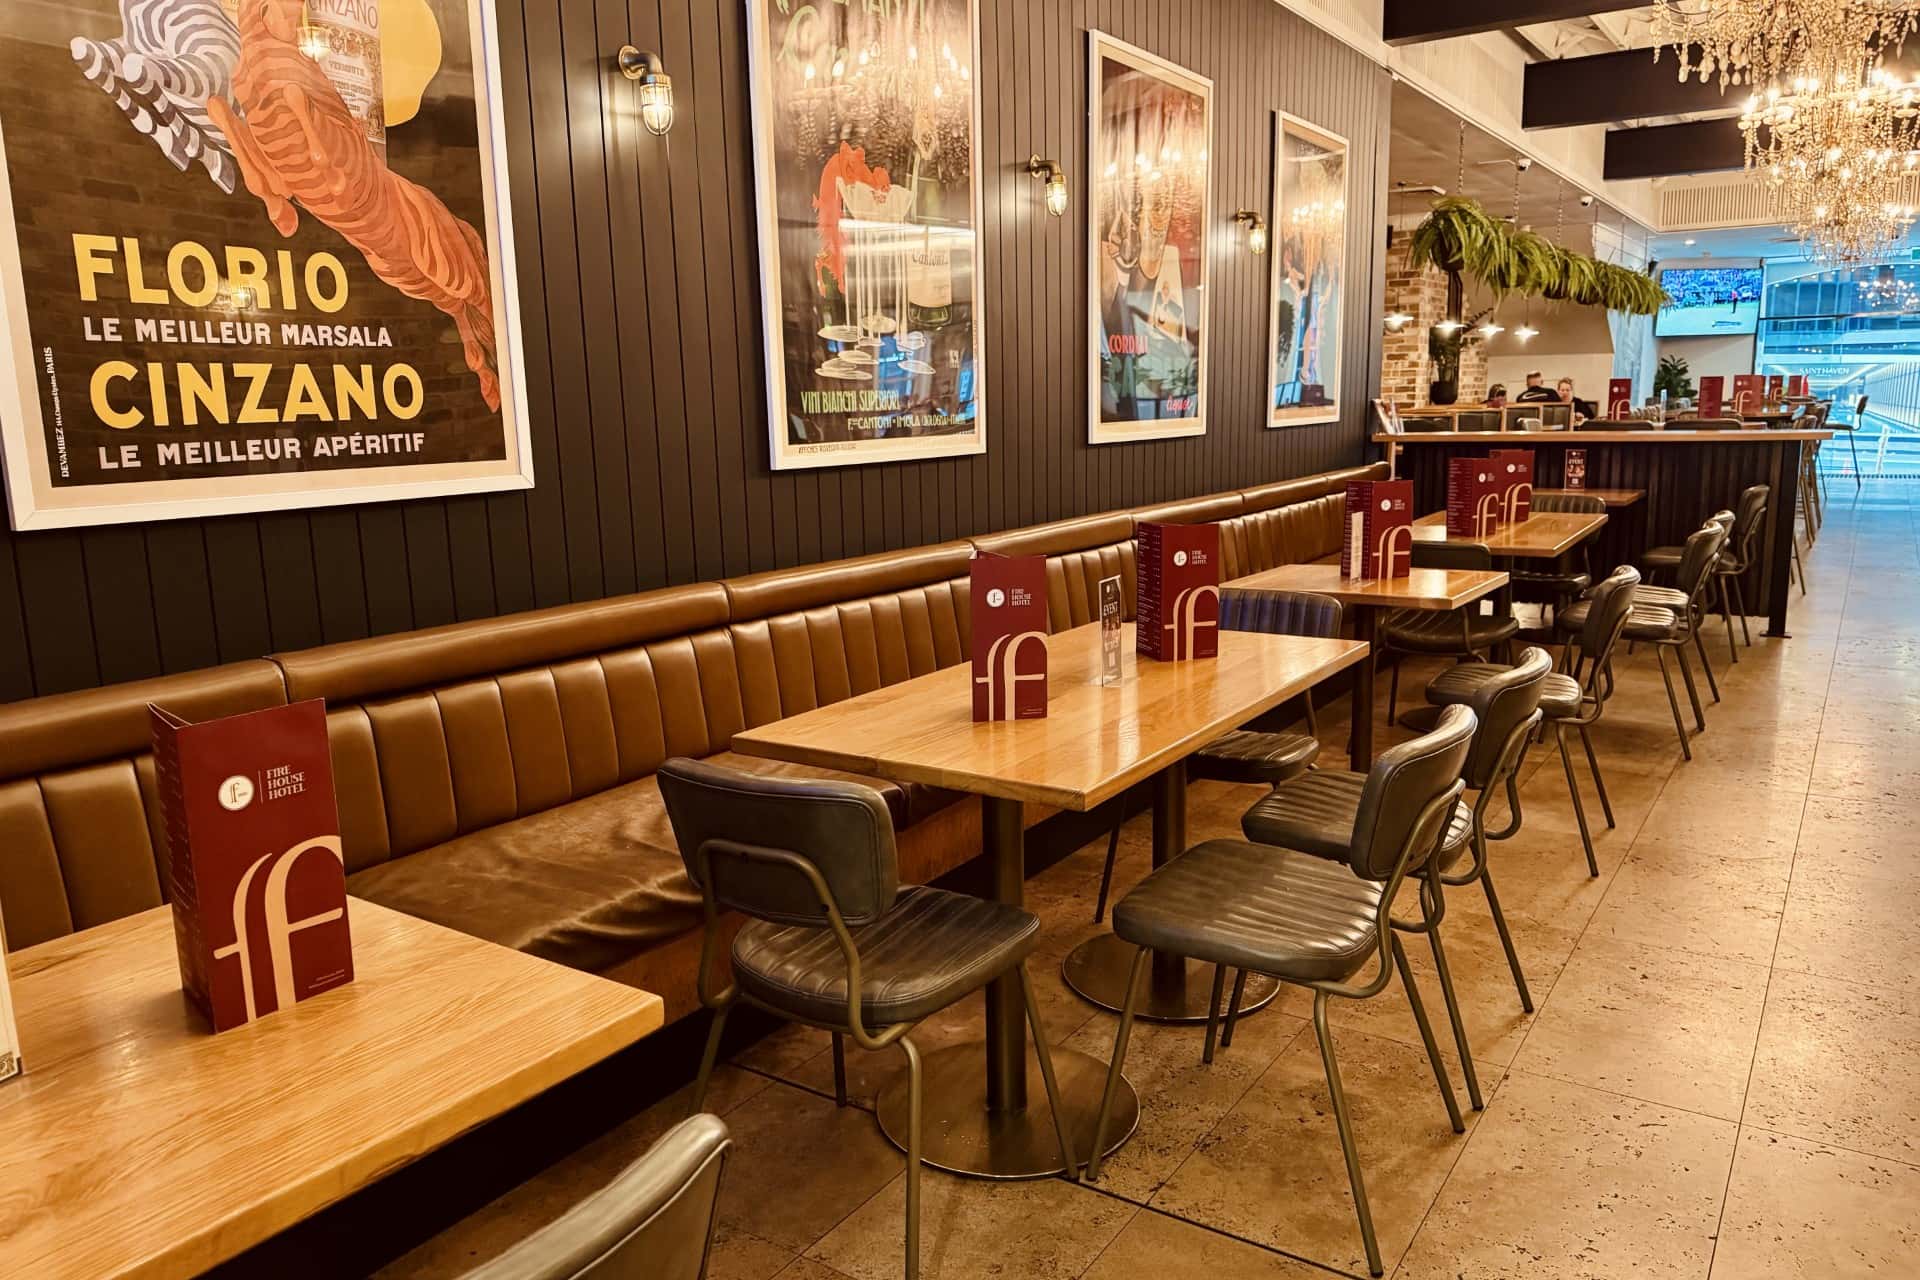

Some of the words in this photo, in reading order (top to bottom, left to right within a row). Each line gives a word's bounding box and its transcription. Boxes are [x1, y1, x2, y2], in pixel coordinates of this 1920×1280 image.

[72, 233, 349, 313] FLORIO
[83, 317, 122, 342] LE
[136, 318, 271, 345] MEILLEUR
[281, 323, 393, 347] MARSALA
[43, 346, 55, 373] PARIS
[90, 360, 424, 429] CINZANO
[801, 391, 822, 414] VINI
[56, 427, 70, 478] DEVAMBEZ
[99, 444, 141, 469] LE
[158, 436, 300, 466] MEILLEUR
[313, 432, 426, 458] APÉRITIF
[266, 764, 291, 779] FIRE
[267, 771, 305, 790] HOUSE
[269, 783, 307, 800] HOTEL
